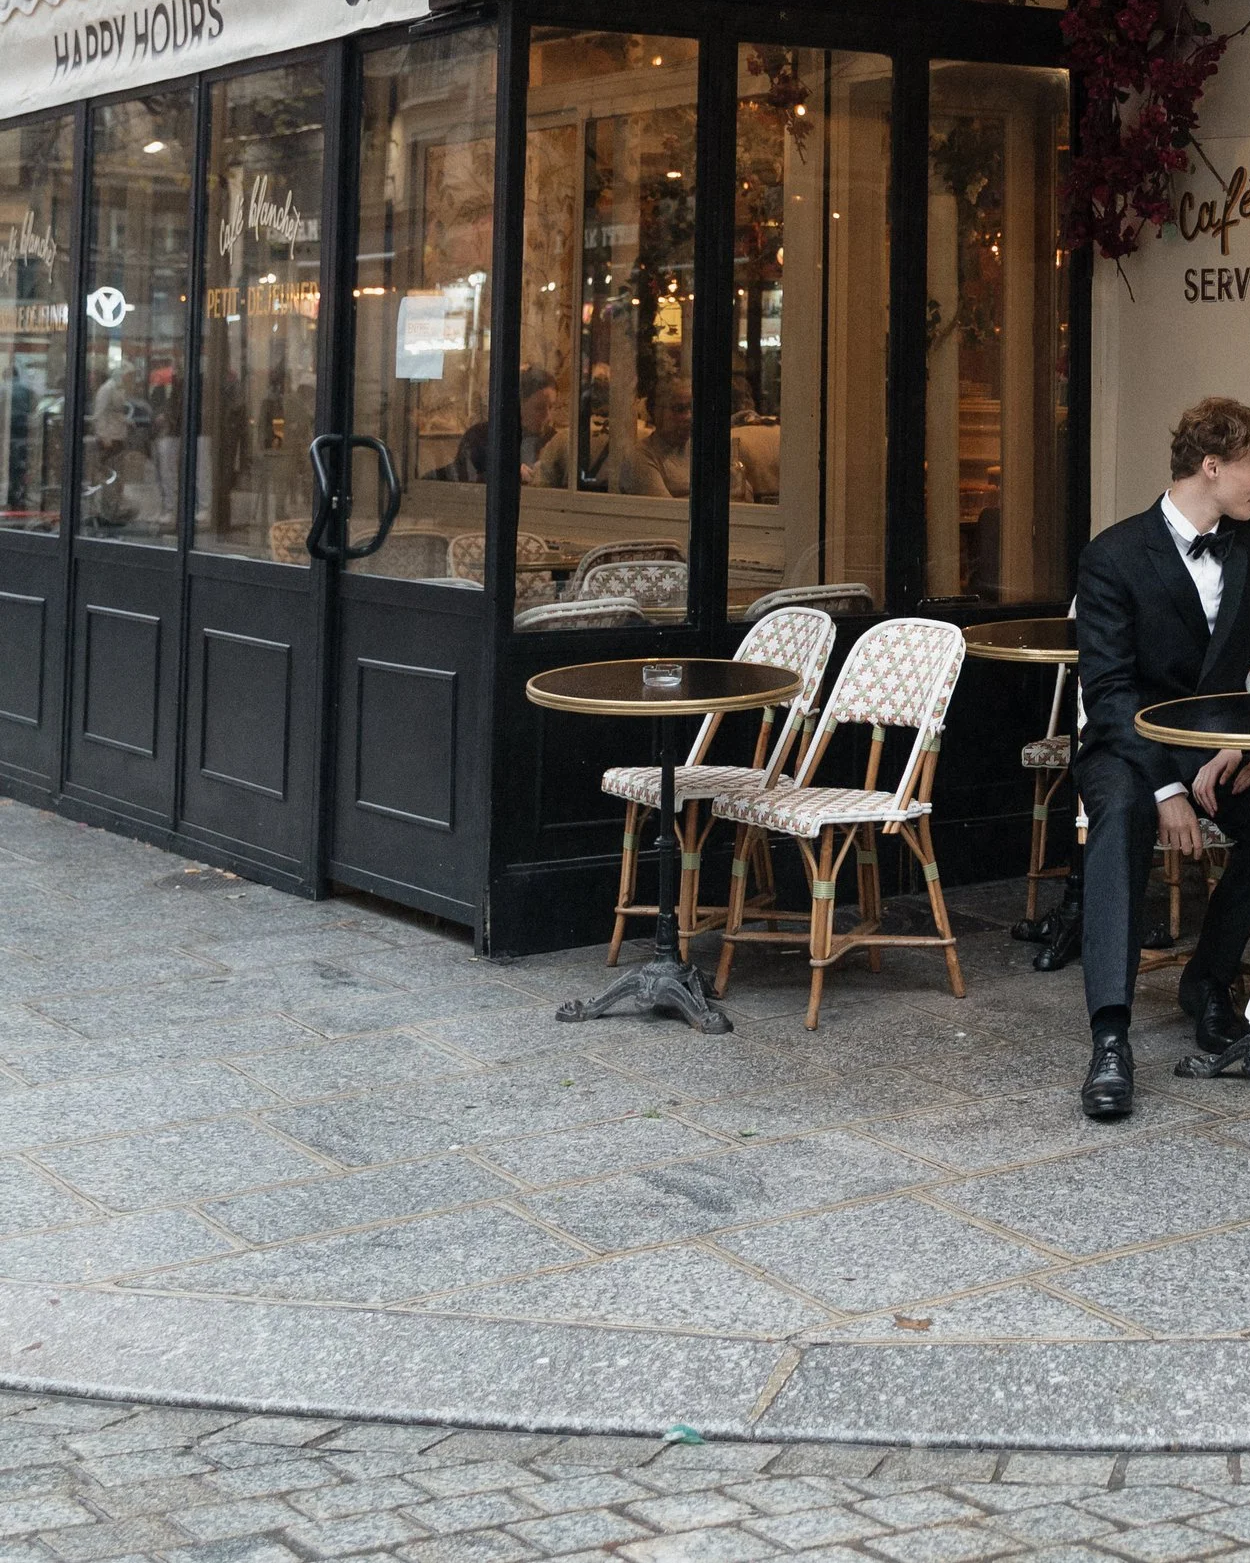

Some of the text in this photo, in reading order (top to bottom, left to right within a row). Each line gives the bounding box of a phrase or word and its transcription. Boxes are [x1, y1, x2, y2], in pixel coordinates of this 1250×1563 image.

[50, 14, 126, 85] HAPPY
[248, 174, 302, 260] blanchet
[207, 287, 240, 318] PETIT
